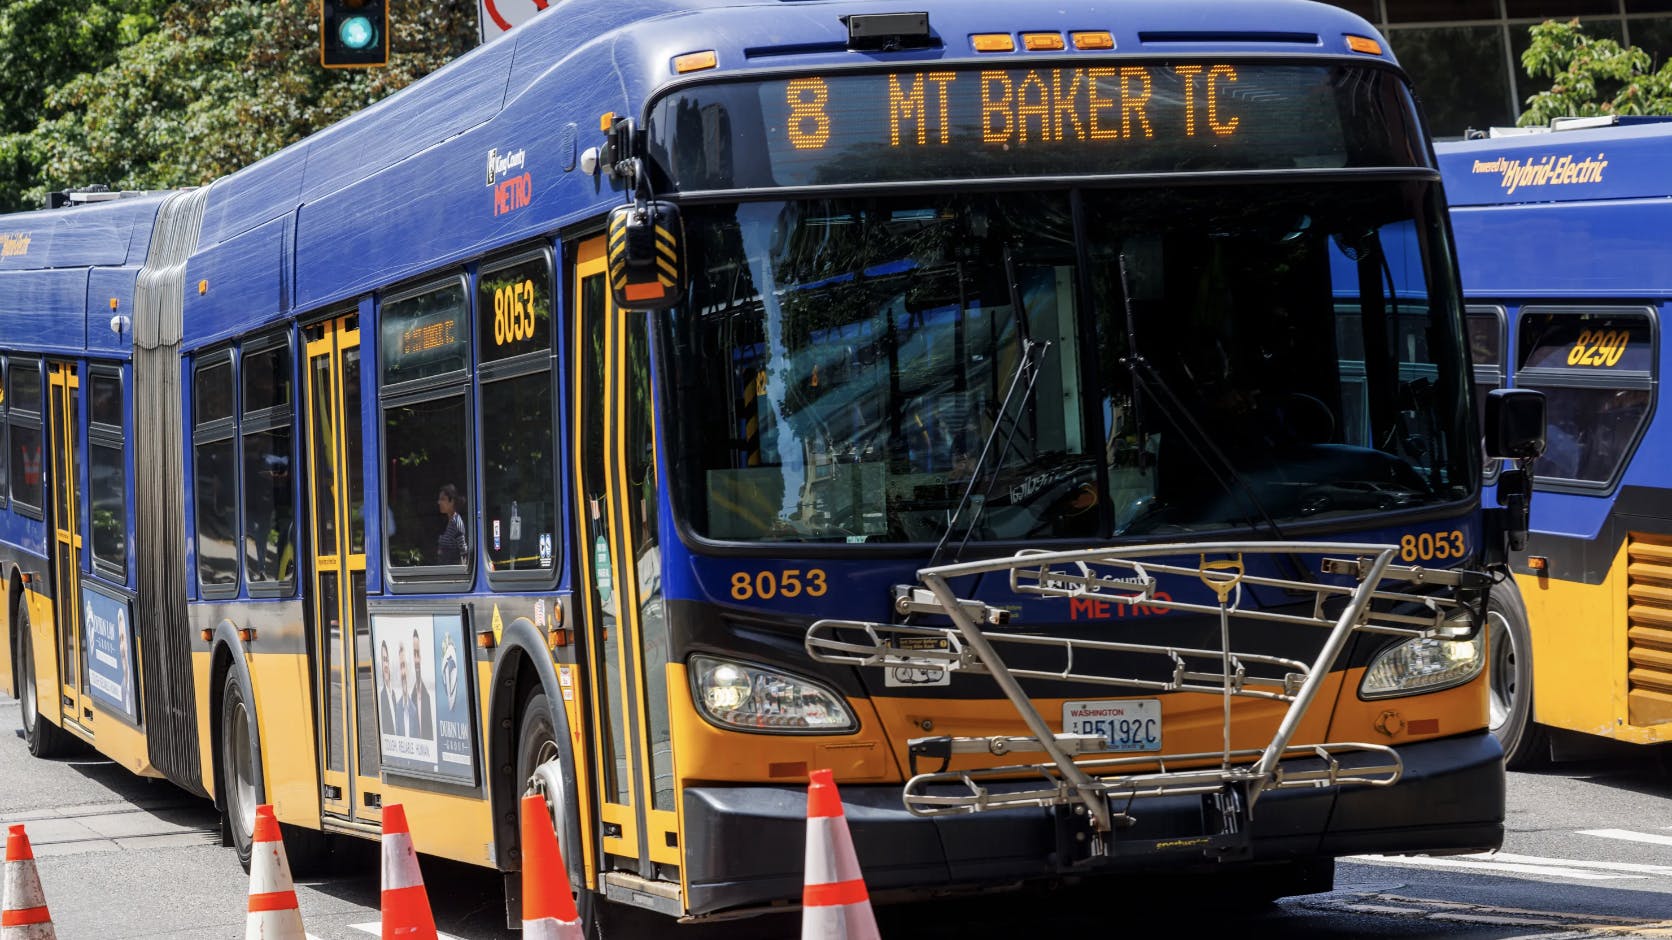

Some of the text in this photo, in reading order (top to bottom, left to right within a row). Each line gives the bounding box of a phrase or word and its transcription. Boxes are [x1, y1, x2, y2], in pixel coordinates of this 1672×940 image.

[787, 64, 1239, 149] 8 MT BAKER TC
[1501, 152, 1608, 195] Hybrid-Electric
[494, 171, 532, 216] METRO
[494, 280, 535, 346] 8053
[1567, 329, 1629, 367] 8290
[1401, 530, 1465, 562] 8053
[730, 569, 828, 601] 8053
[1070, 591, 1172, 620] METRO
[1071, 708, 1124, 717] WASHINGTON
